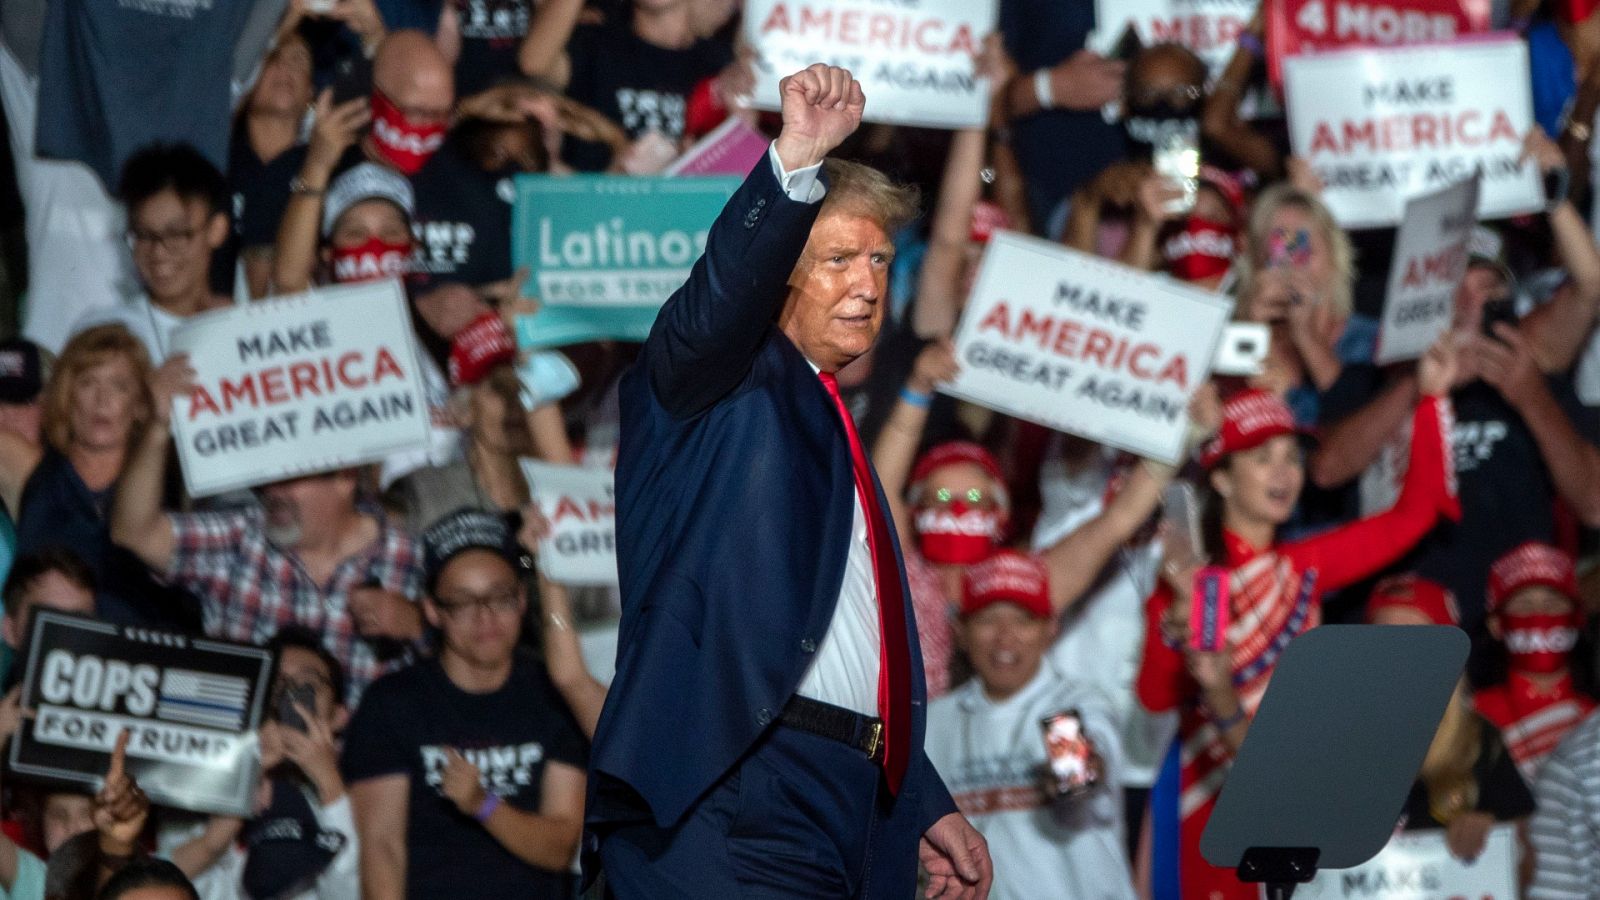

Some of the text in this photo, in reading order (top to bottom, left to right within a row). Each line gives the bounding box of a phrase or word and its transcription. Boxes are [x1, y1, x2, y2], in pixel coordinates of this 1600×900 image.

[760, 3, 979, 56] AMERICA
[1296, 1, 1457, 42] 4 MORE
[875, 61, 976, 94] AGAIN
[1363, 75, 1455, 105] MAKE
[1308, 109, 1519, 154] AMERICA
[1320, 161, 1414, 190] REAT
[1054, 280, 1147, 331] MAKE
[236, 321, 333, 363] MAKE
[977, 299, 1190, 391] AMERICA
[187, 346, 406, 421] AMERICA
[965, 340, 1072, 393] GREAT
[1077, 376, 1183, 424] AGAIN
[192, 393, 416, 458] GREAT AGAIN
[40, 647, 161, 718] COPS
[43, 715, 232, 757] FOR TRUMP
[1342, 866, 1440, 898] MAKE
